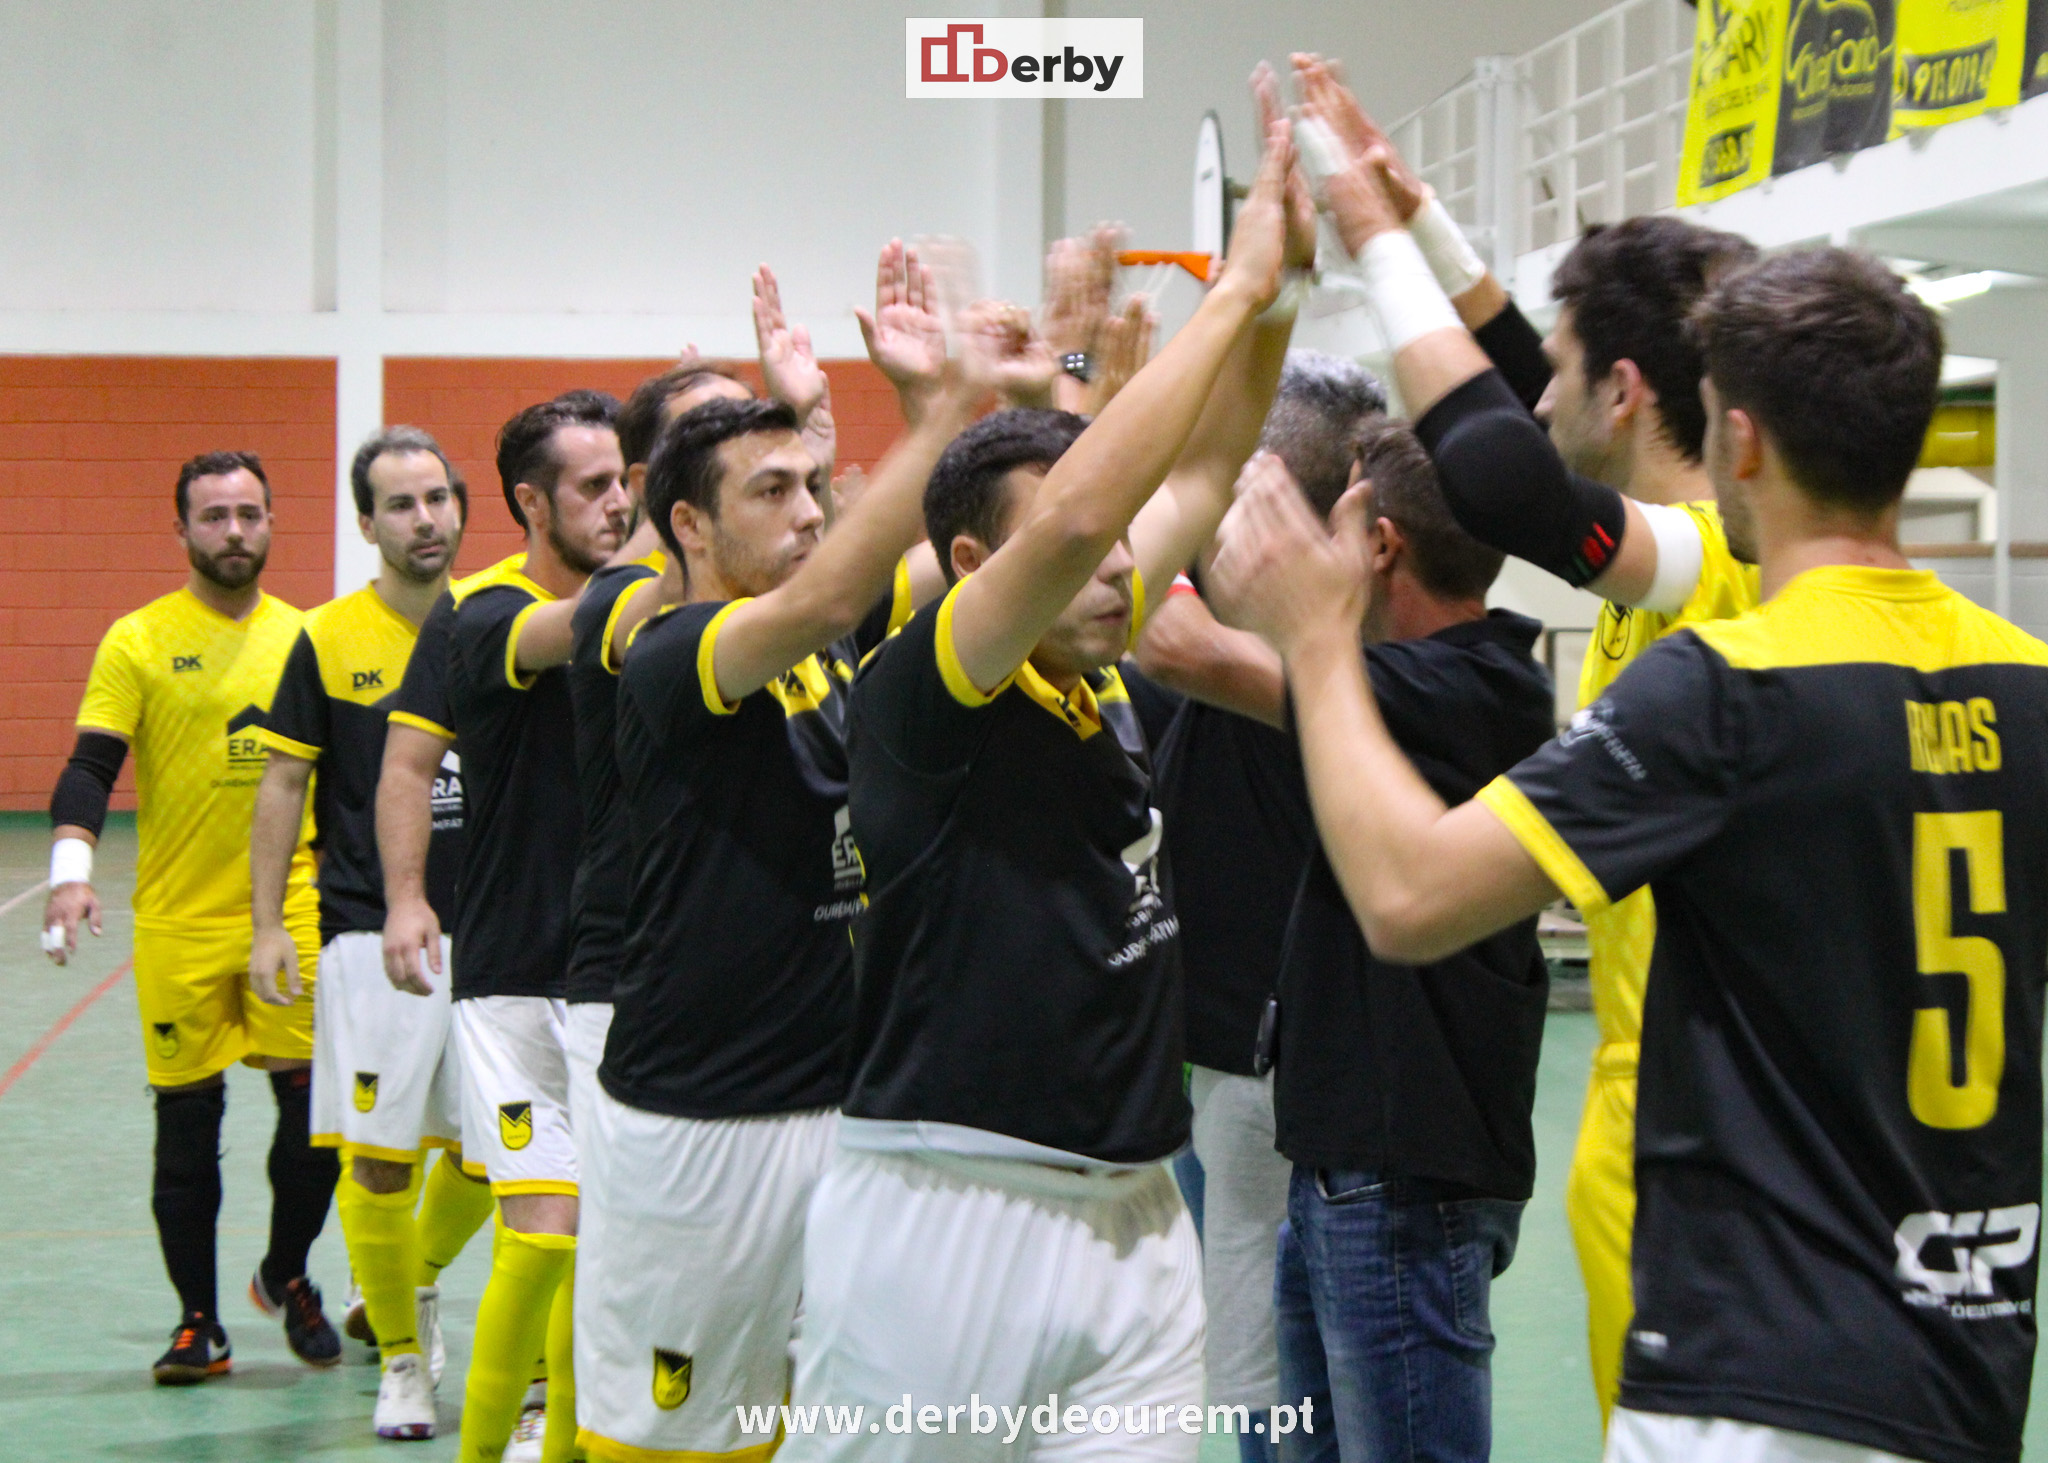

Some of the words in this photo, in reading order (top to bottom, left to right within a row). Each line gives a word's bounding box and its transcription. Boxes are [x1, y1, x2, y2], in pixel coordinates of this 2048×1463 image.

[172, 654, 202, 672] DK
[352, 669, 384, 688] DK
[432, 776, 463, 797] RA
[1908, 810, 2006, 1129] 5
